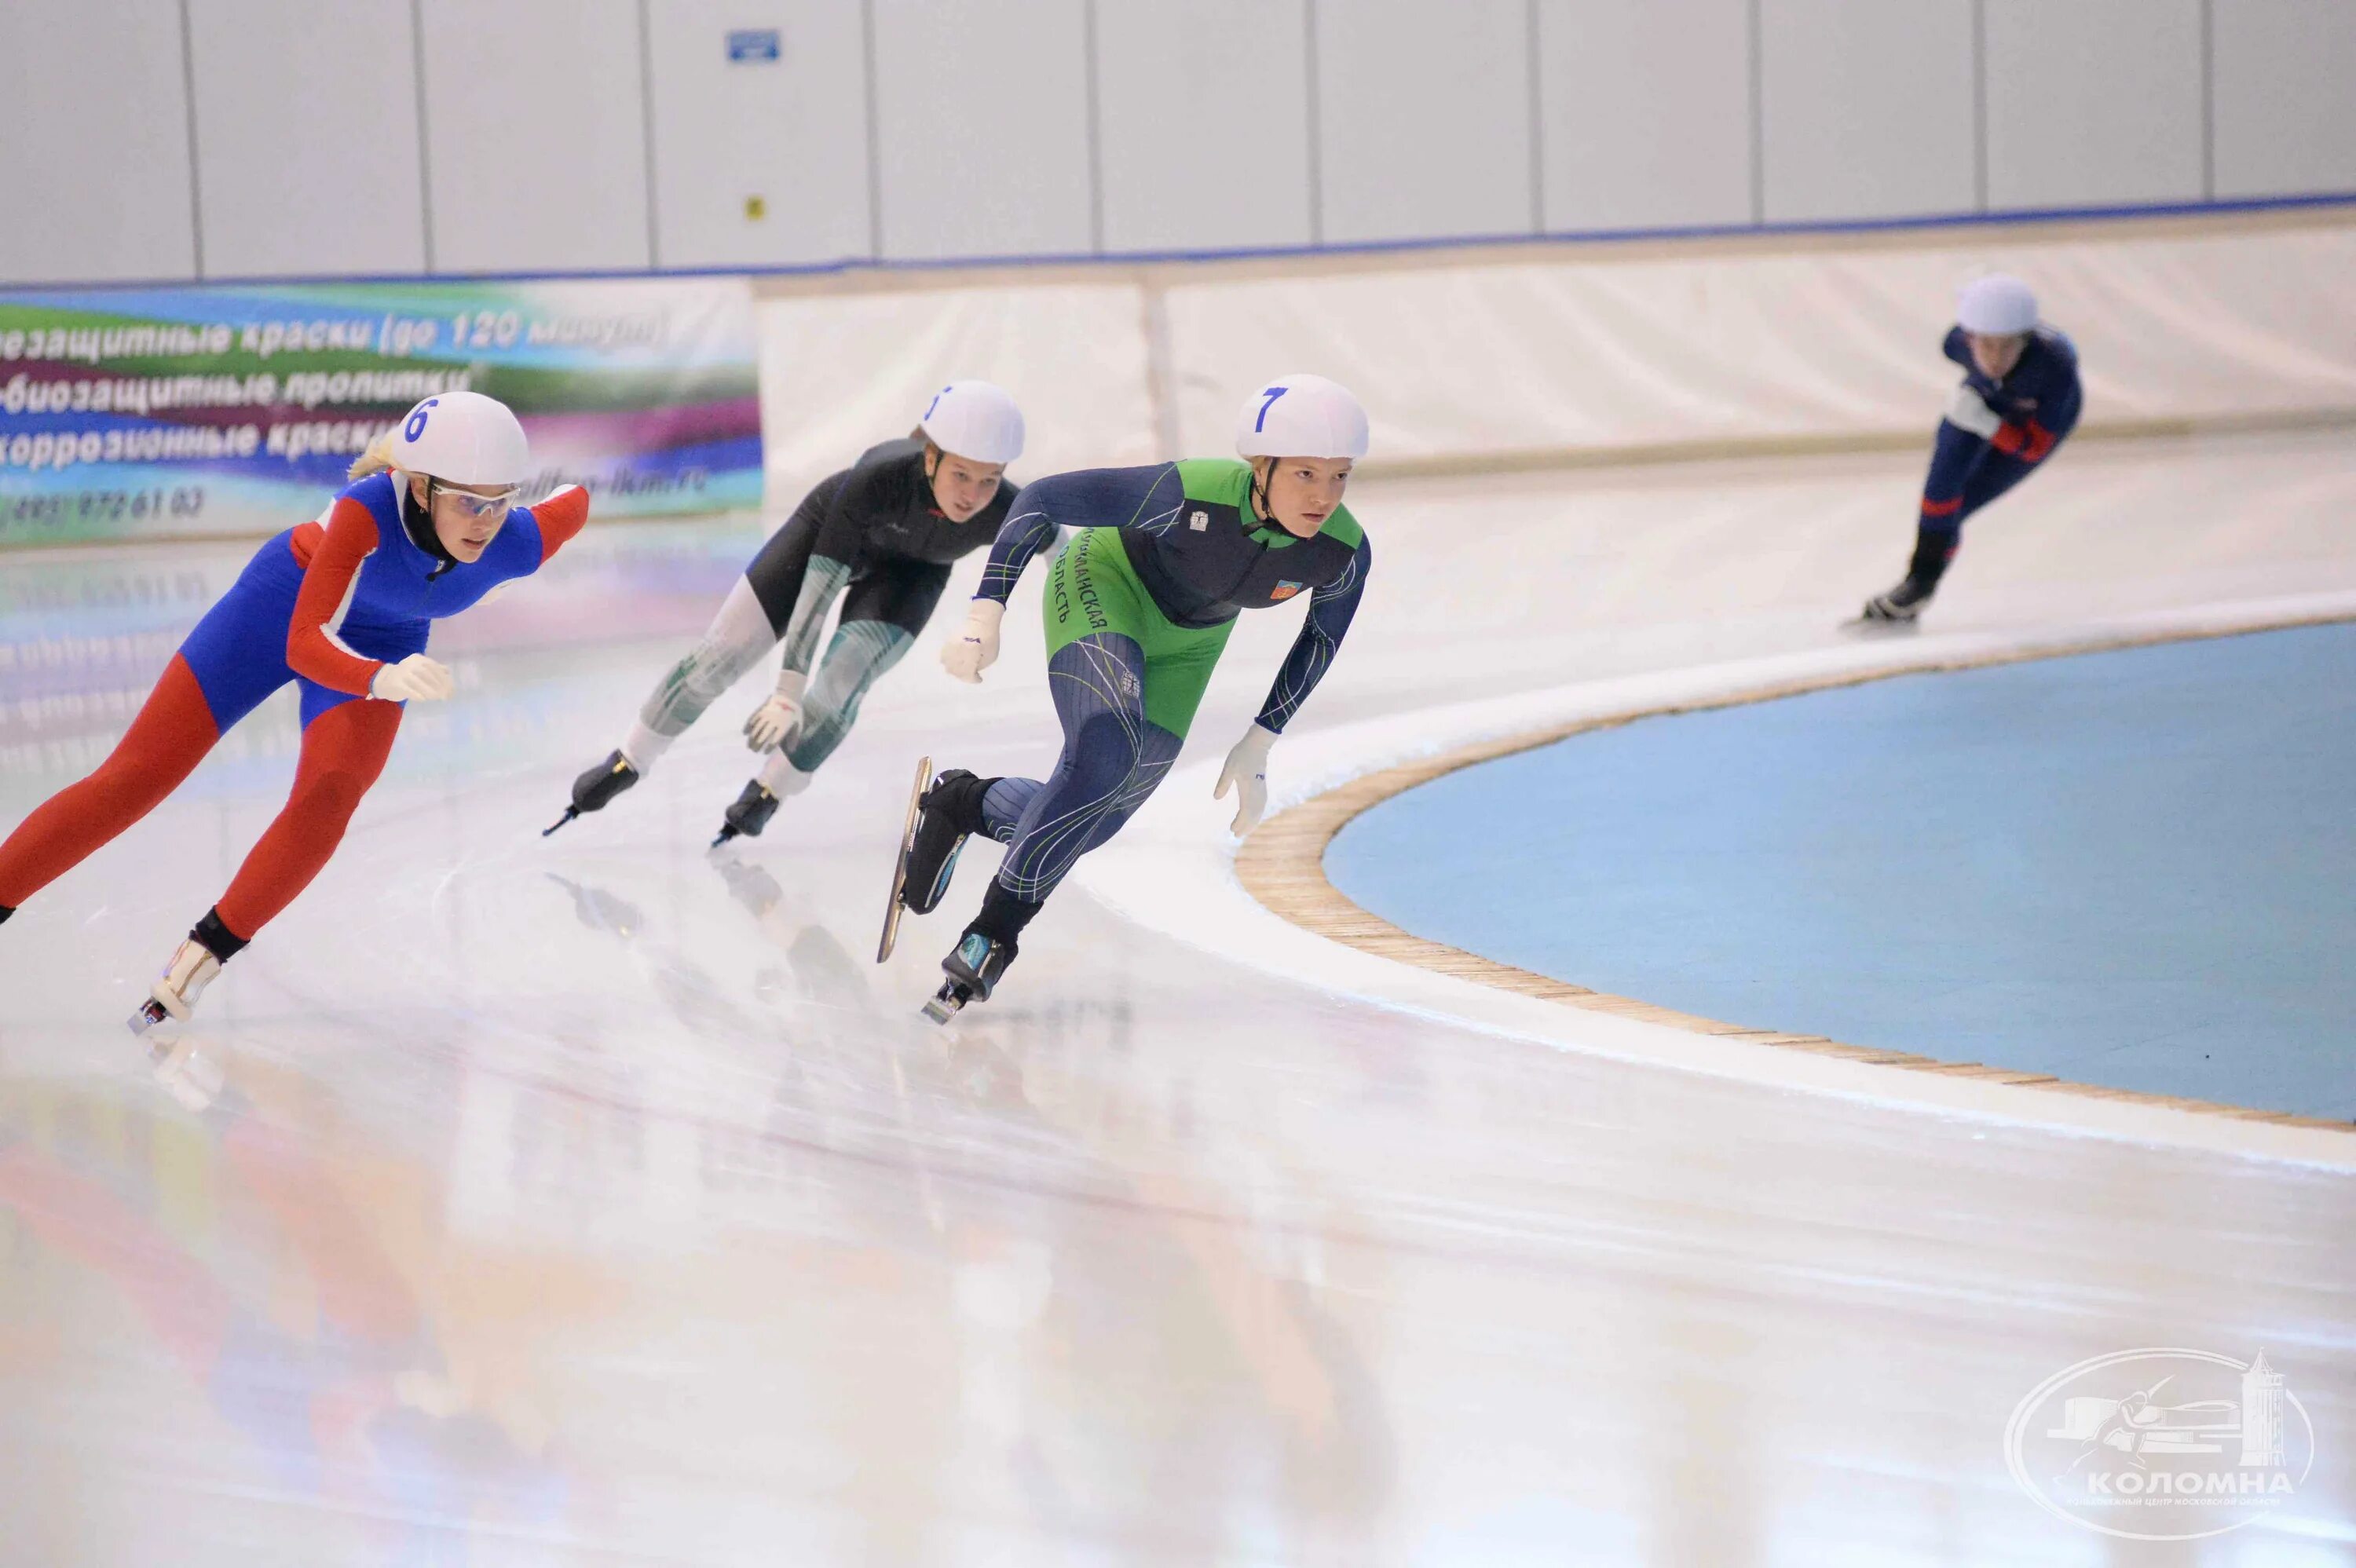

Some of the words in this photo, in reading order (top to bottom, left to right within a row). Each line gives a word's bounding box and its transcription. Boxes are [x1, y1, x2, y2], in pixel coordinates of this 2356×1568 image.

[0, 324, 232, 366] езащитные
[240, 319, 374, 360] краски
[452, 309, 522, 348] 120
[404, 399, 439, 443] 6
[1255, 387, 1289, 433] 7
